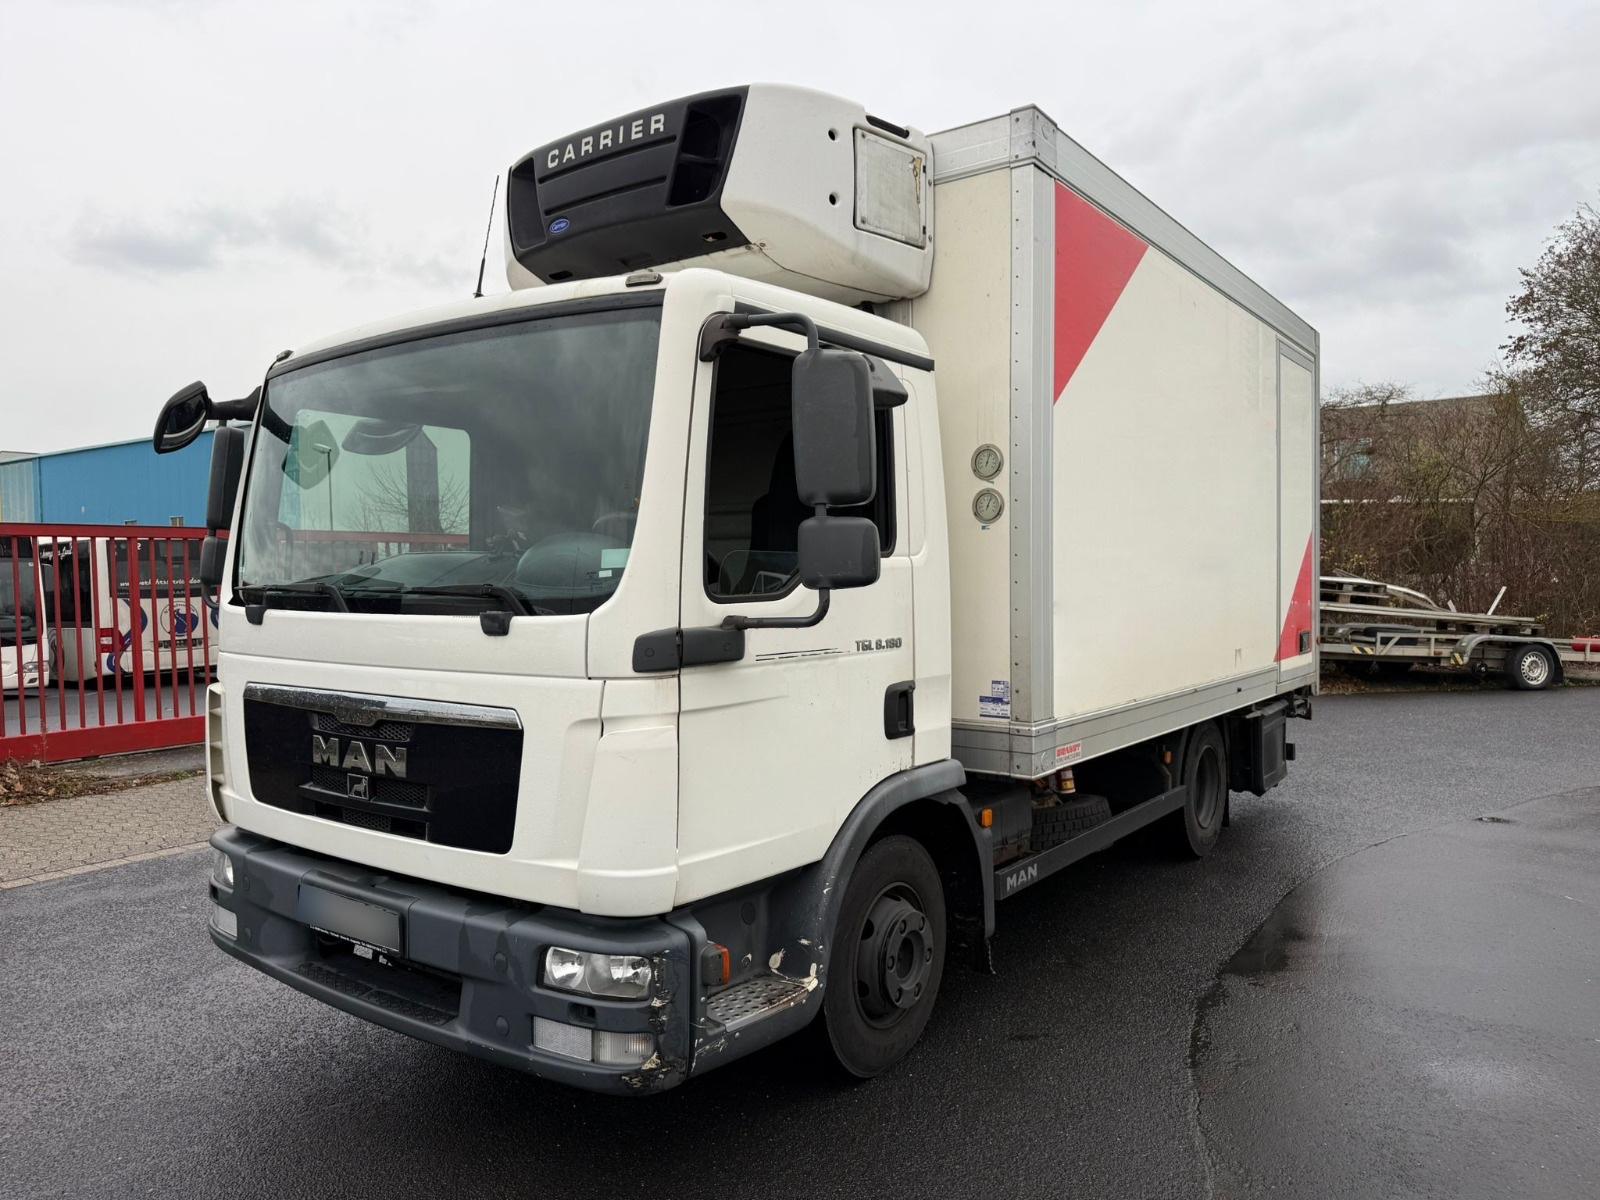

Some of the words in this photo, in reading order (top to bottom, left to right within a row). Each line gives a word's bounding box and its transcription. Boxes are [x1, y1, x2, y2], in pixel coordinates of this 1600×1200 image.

[547, 113, 665, 169] CARRIER
[855, 640, 874, 651] TGL
[312, 734, 407, 778] MAN
[1006, 863, 1038, 891] MAN
